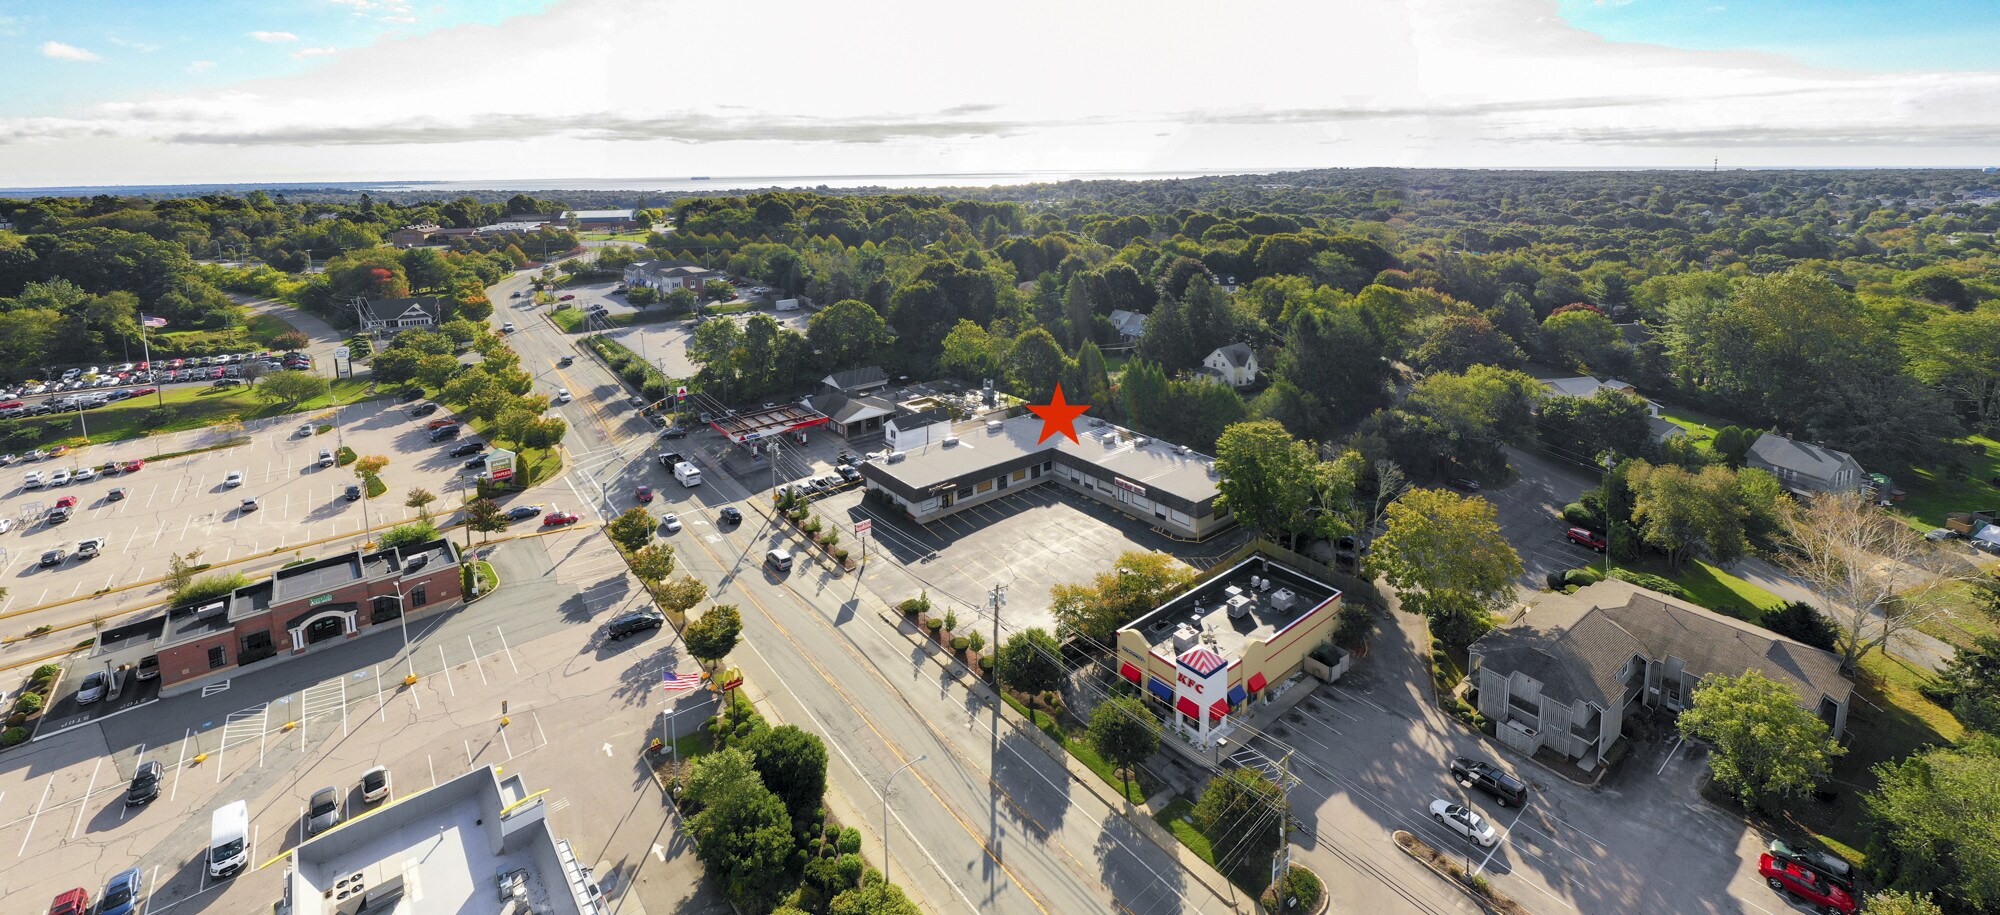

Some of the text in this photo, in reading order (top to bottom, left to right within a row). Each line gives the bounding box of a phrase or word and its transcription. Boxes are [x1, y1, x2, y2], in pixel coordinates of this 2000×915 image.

[1177, 672, 1204, 694] KFC
[119, 697, 147, 709] STOP
[60, 715, 90, 728] STOP
